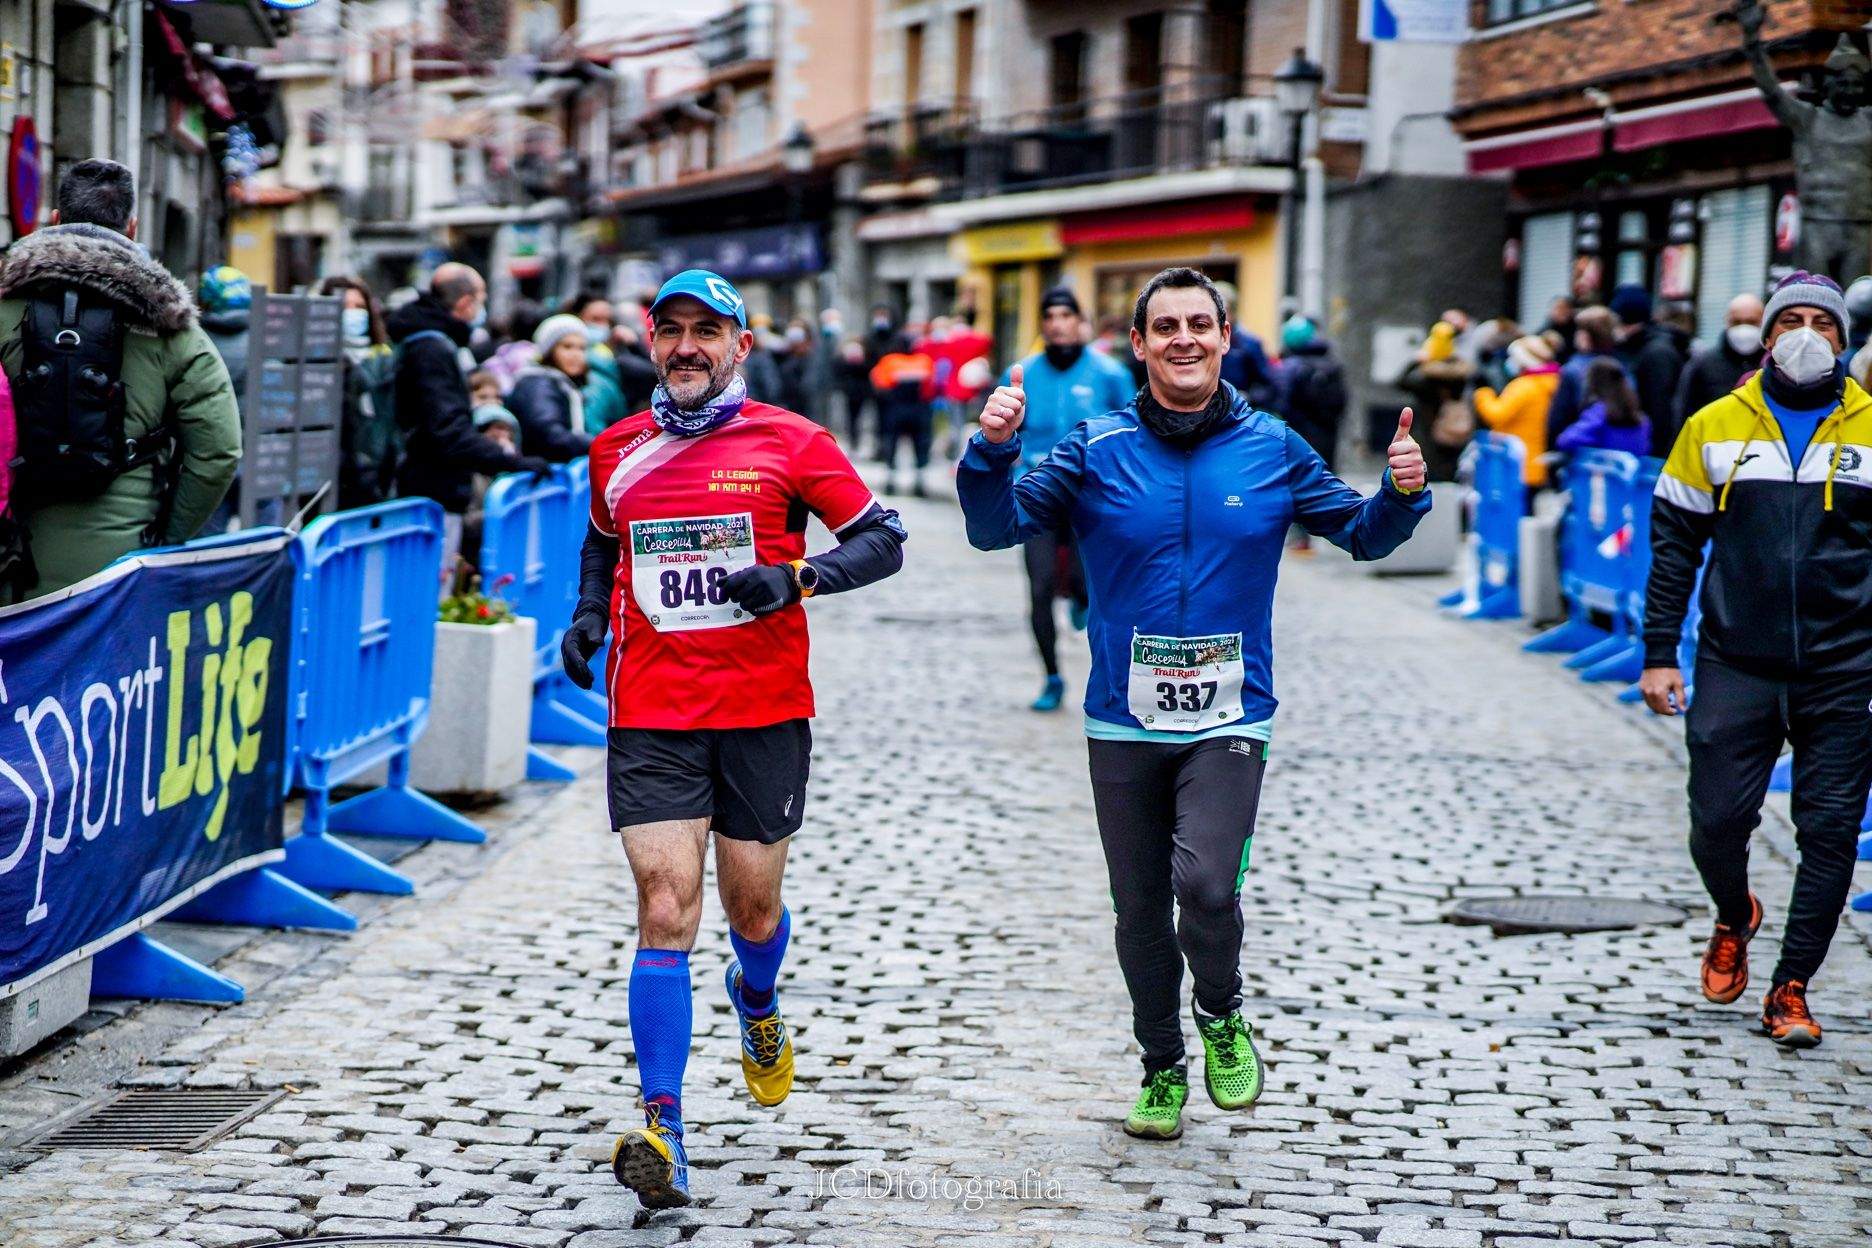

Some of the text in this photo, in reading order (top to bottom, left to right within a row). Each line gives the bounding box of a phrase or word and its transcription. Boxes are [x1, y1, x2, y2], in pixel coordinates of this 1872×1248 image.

[616, 428, 654, 459] Joma
[740, 483, 752, 493] 24
[754, 483, 761, 494] H
[636, 525, 674, 535] CARRERA
[685, 521, 724, 533] NAVIDAD
[726, 520, 744, 529] 2021
[657, 552, 702, 564] Trail Run
[659, 566, 731, 609] 848
[1137, 640, 1170, 650] CARRERA
[1181, 642, 1217, 650] NAVIDAD
[1153, 668, 1195, 680] Trail Run
[1156, 680, 1218, 712] 337
